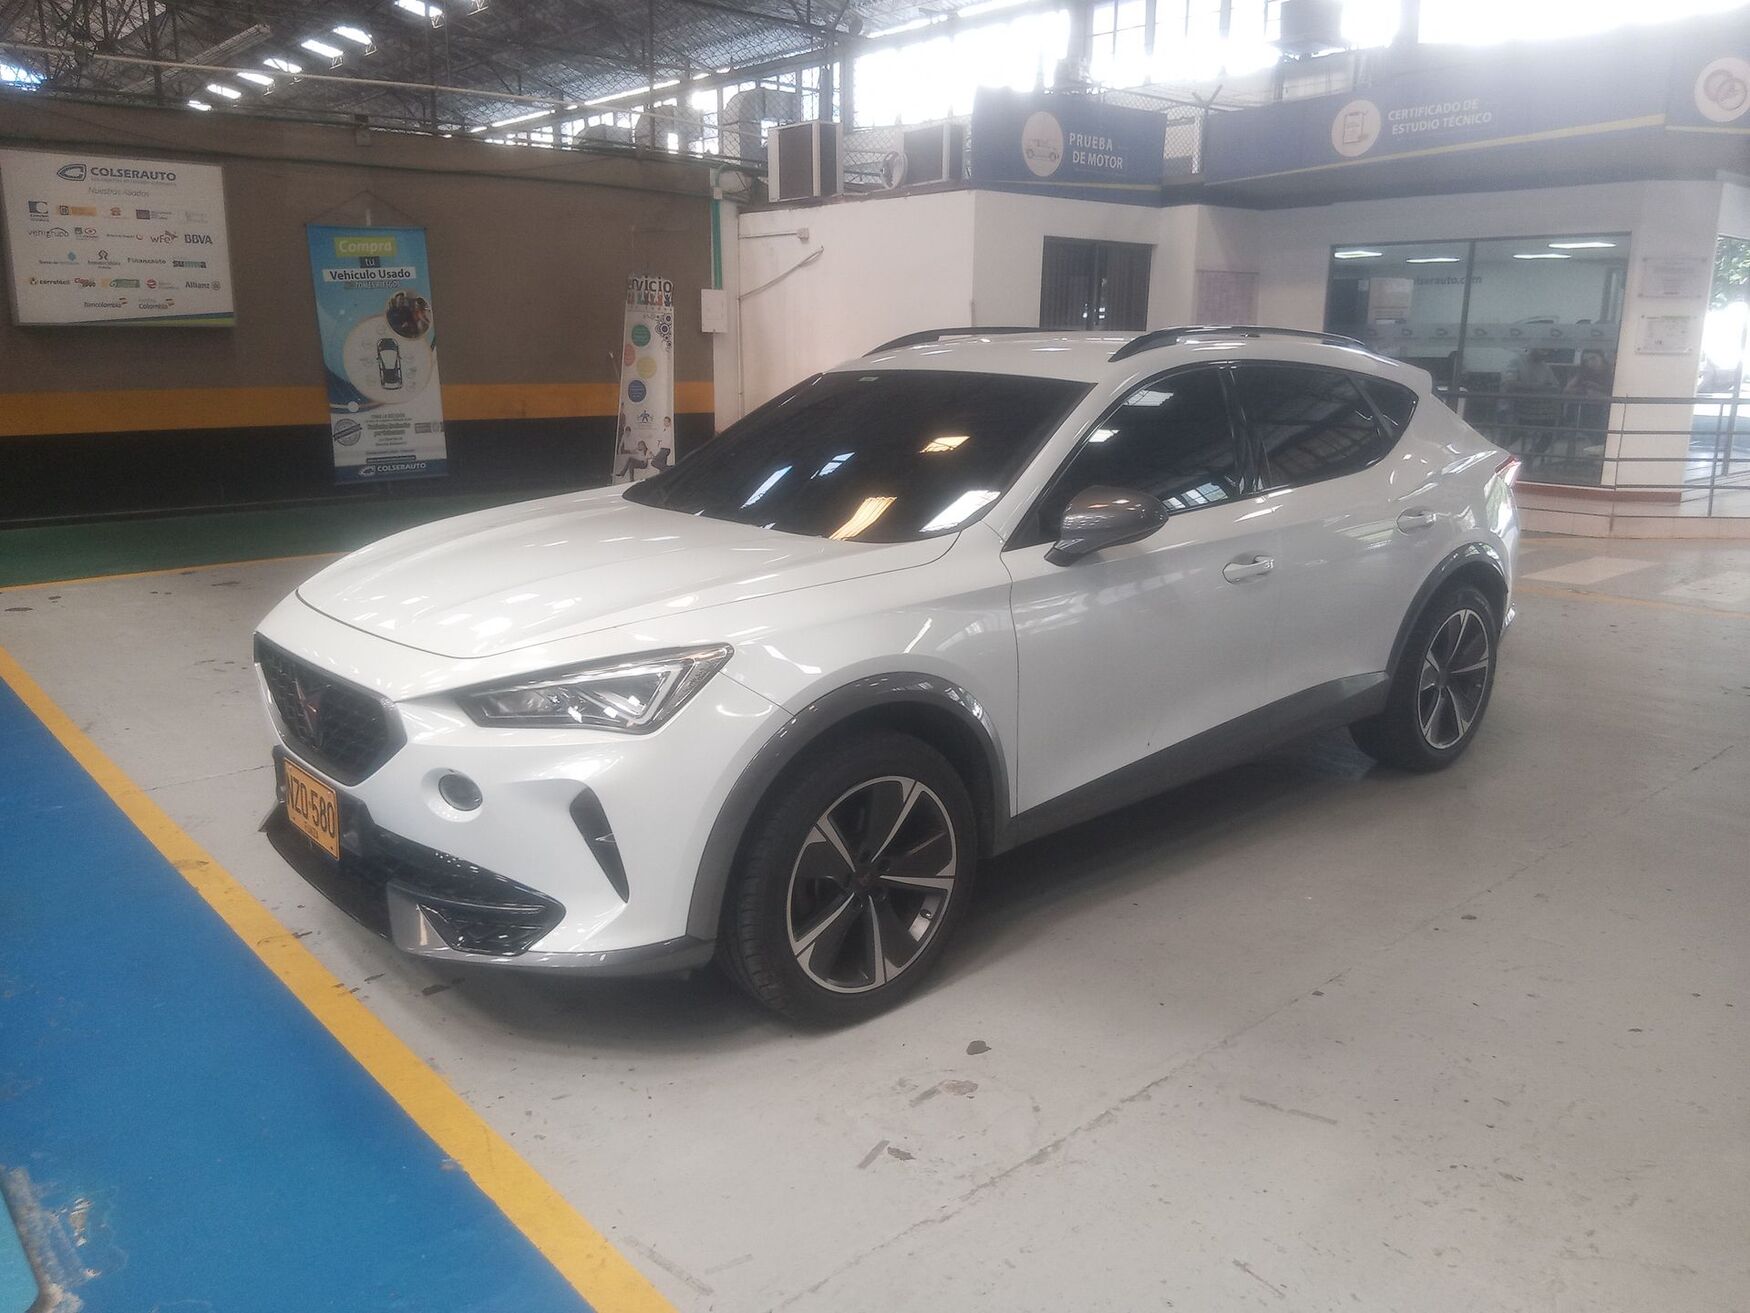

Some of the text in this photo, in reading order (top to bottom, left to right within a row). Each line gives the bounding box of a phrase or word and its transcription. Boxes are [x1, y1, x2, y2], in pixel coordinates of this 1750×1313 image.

[1388, 98, 1479, 121] CERTIFICADO DE
[1392, 119, 1439, 135] ESTUDIO
[1069, 132, 1113, 151] PRUEBA
[1072, 151, 1123, 169] DE MOTOR
[90, 167, 177, 181] COLSERAUTO
[184, 234, 213, 244] BBVA
[339, 241, 393, 254] Compra
[379, 268, 411, 279] Usado
[185, 281, 210, 289] Allianz
[377, 462, 427, 472] COLSERAUTO
